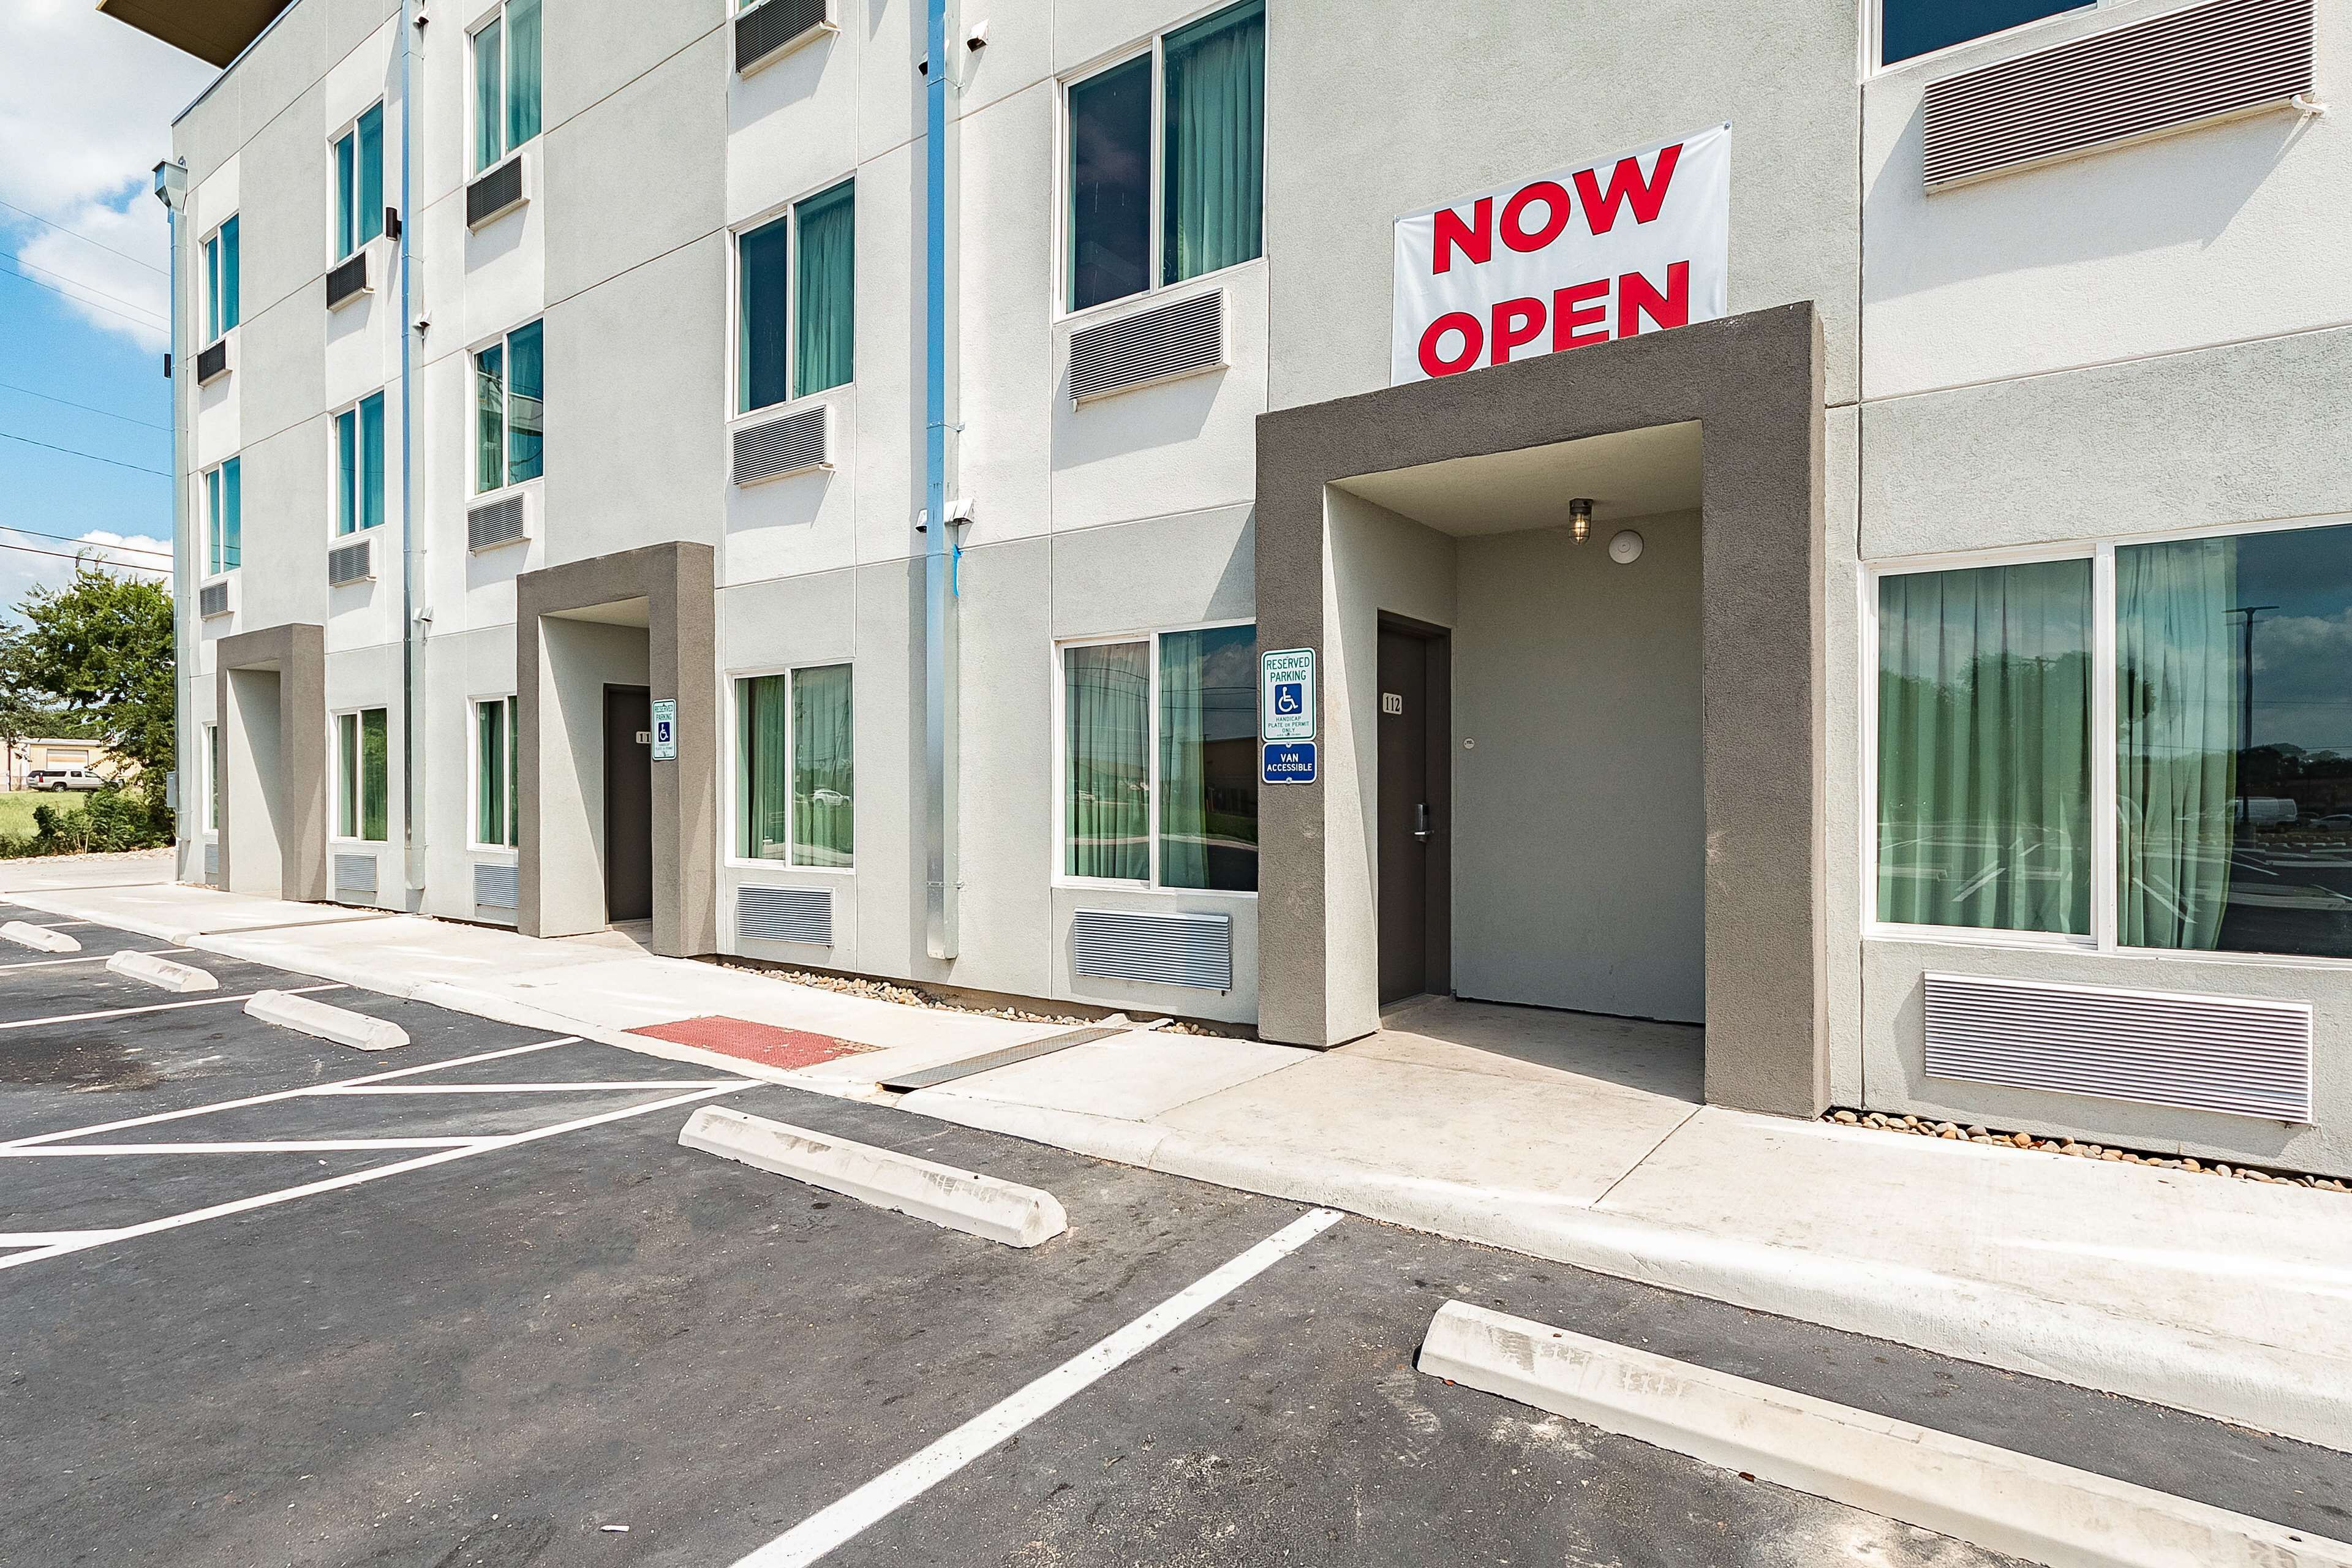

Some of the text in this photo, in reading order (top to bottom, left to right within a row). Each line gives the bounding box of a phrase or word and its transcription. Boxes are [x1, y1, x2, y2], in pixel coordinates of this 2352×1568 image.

[1433, 143, 1683, 275] NOW
[1419, 260, 1689, 378] OPEN
[1267, 657, 1310, 670] RESERVED
[1270, 670, 1306, 682] PARKING
[1385, 695, 1400, 712] 112
[639, 733, 650, 742] 11
[1280, 753, 1298, 763] VAN
[1267, 763, 1313, 772] ACCESSIBLE
